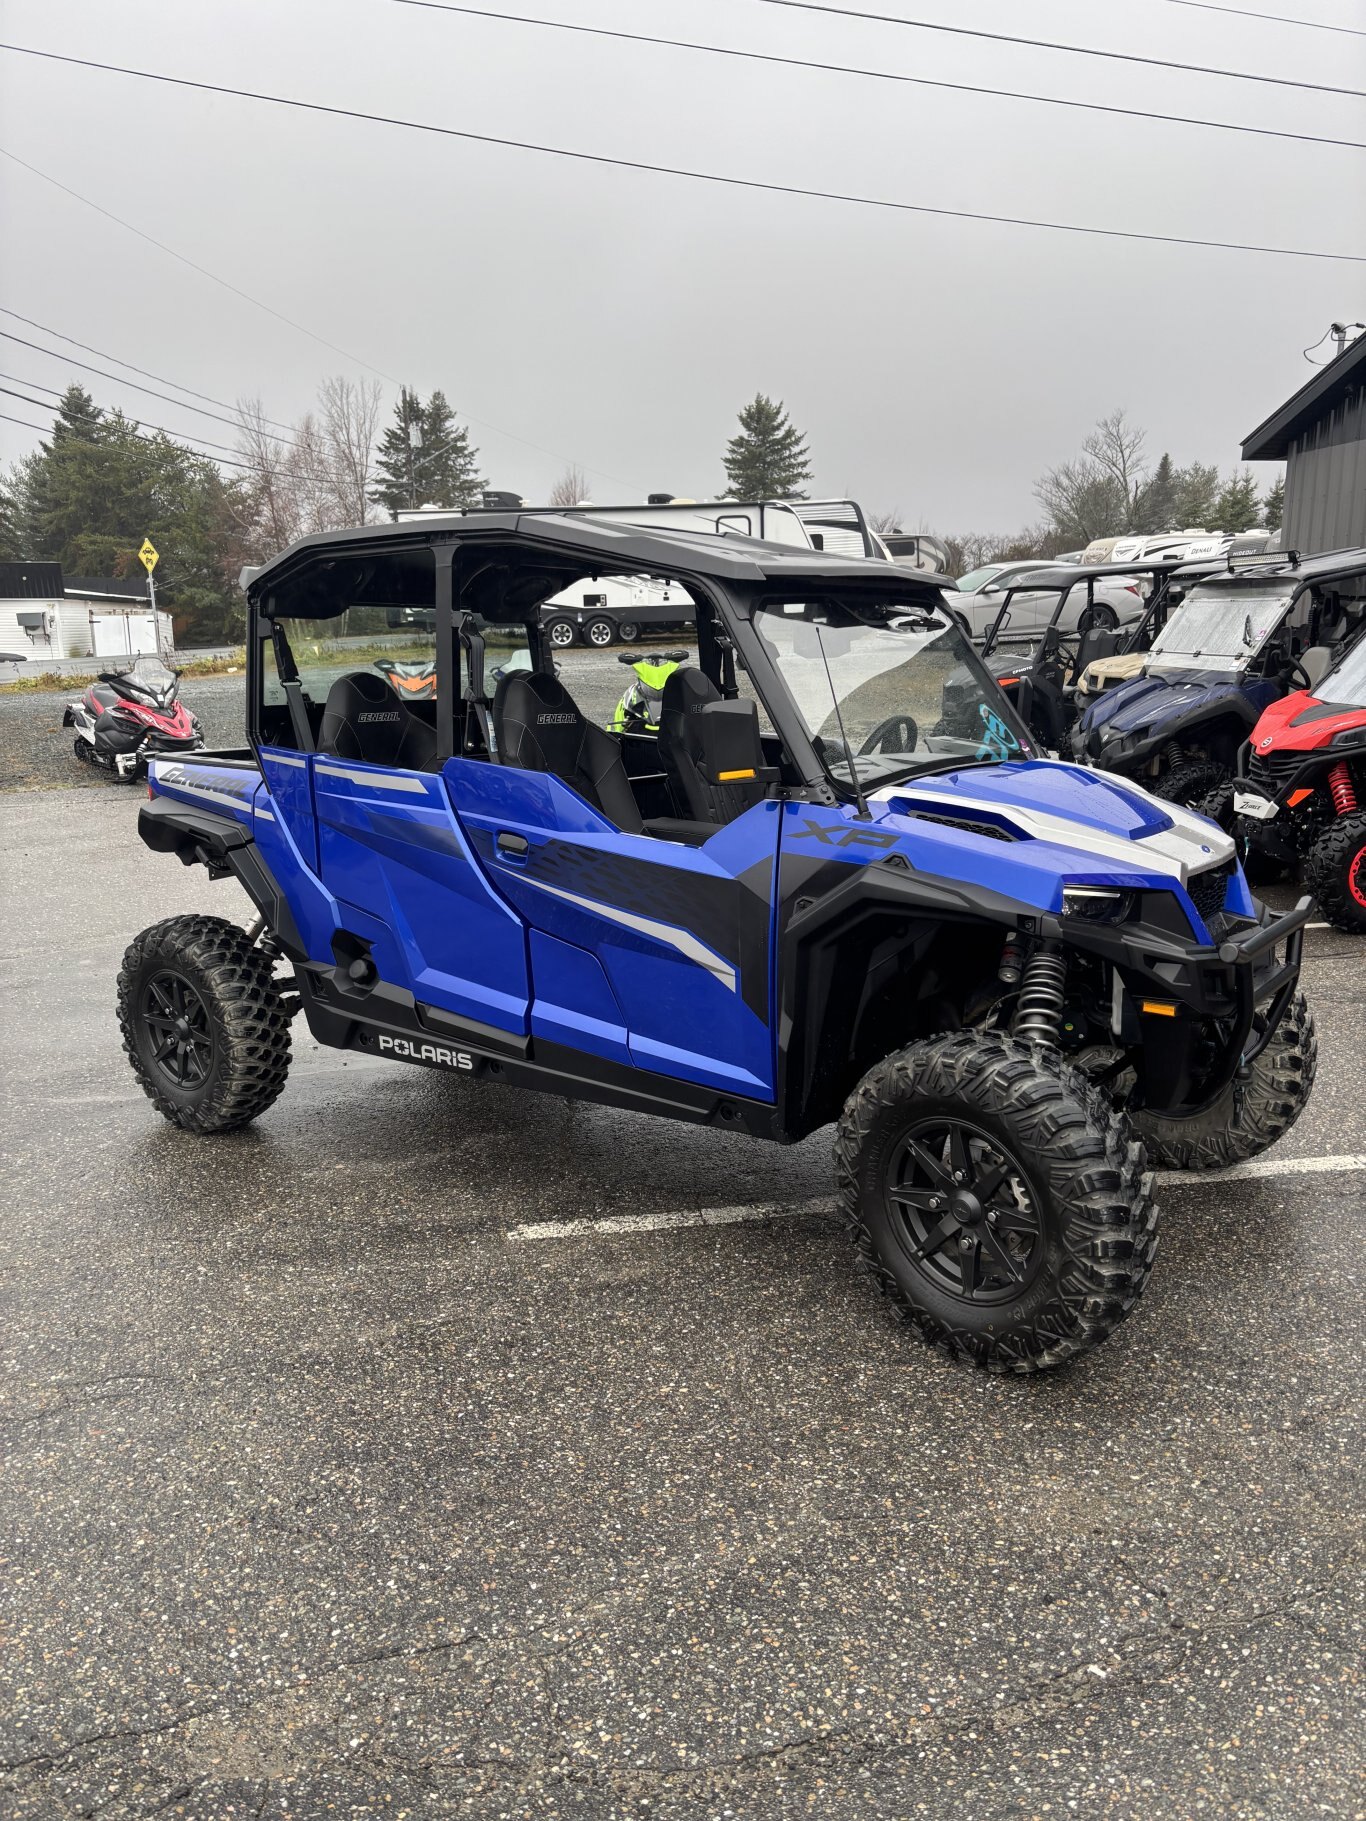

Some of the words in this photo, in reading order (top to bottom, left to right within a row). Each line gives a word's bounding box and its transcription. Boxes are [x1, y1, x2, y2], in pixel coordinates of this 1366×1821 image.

[357, 711, 401, 723] GENERAL
[536, 713, 577, 725] GENERAL
[159, 766, 253, 798] GENERAL
[785, 818, 901, 849] XP
[378, 1034, 473, 1070] POLARIS
